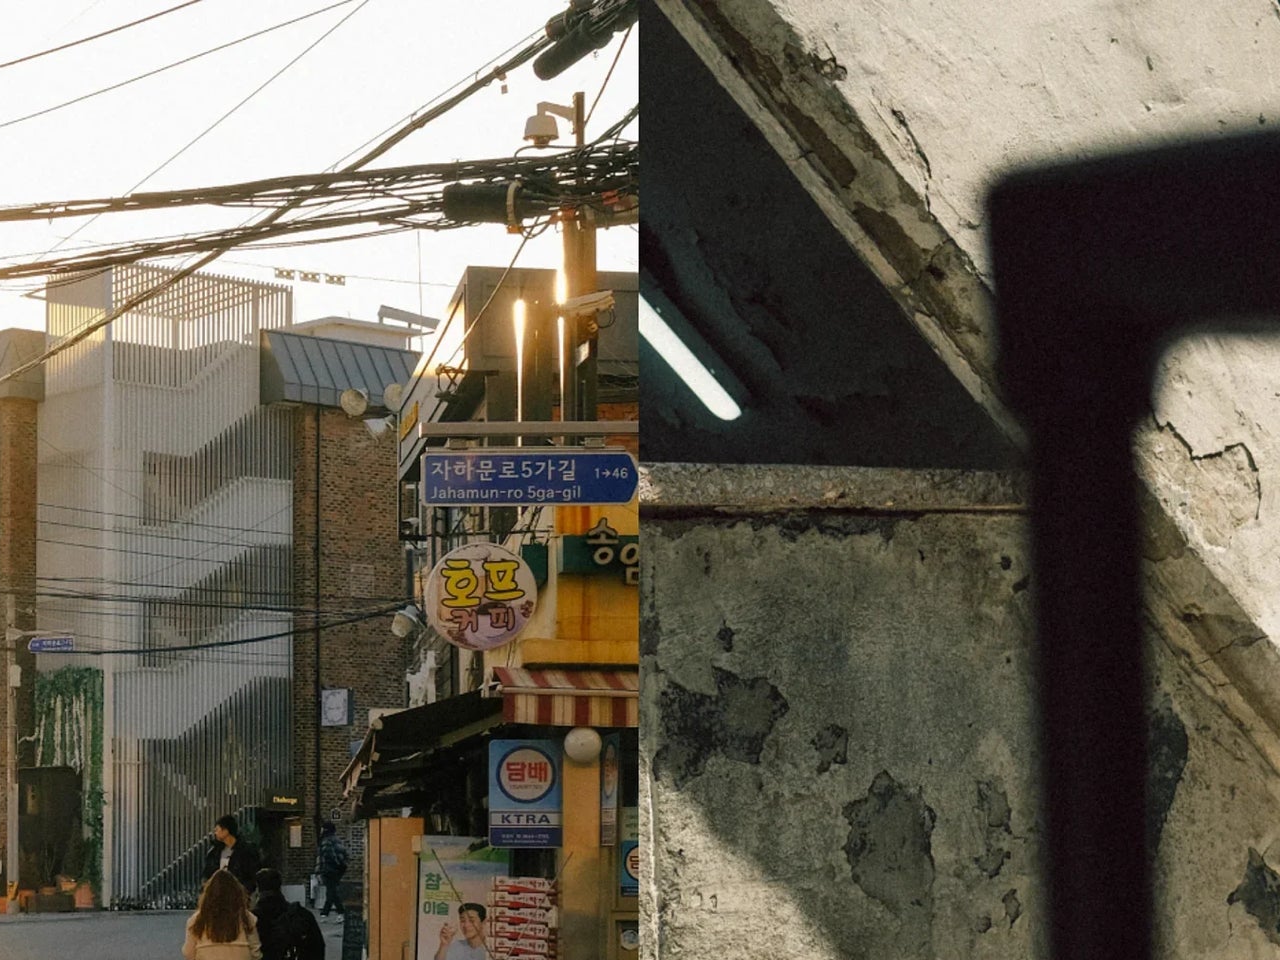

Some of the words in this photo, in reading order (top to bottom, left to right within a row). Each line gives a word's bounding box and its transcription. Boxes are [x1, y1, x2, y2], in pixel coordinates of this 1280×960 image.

[431, 459, 577, 482] 자하문로5가길
[431, 486, 523, 500] Jahamun-ro
[527, 485, 582, 501] 5ga-gil
[441, 558, 525, 608] 호프
[447, 606, 516, 633] 커피
[506, 761, 549, 783] 담배
[501, 813, 551, 825] KTRA
[424, 872, 442, 891] 참
[423, 901, 449, 916] 이슬
